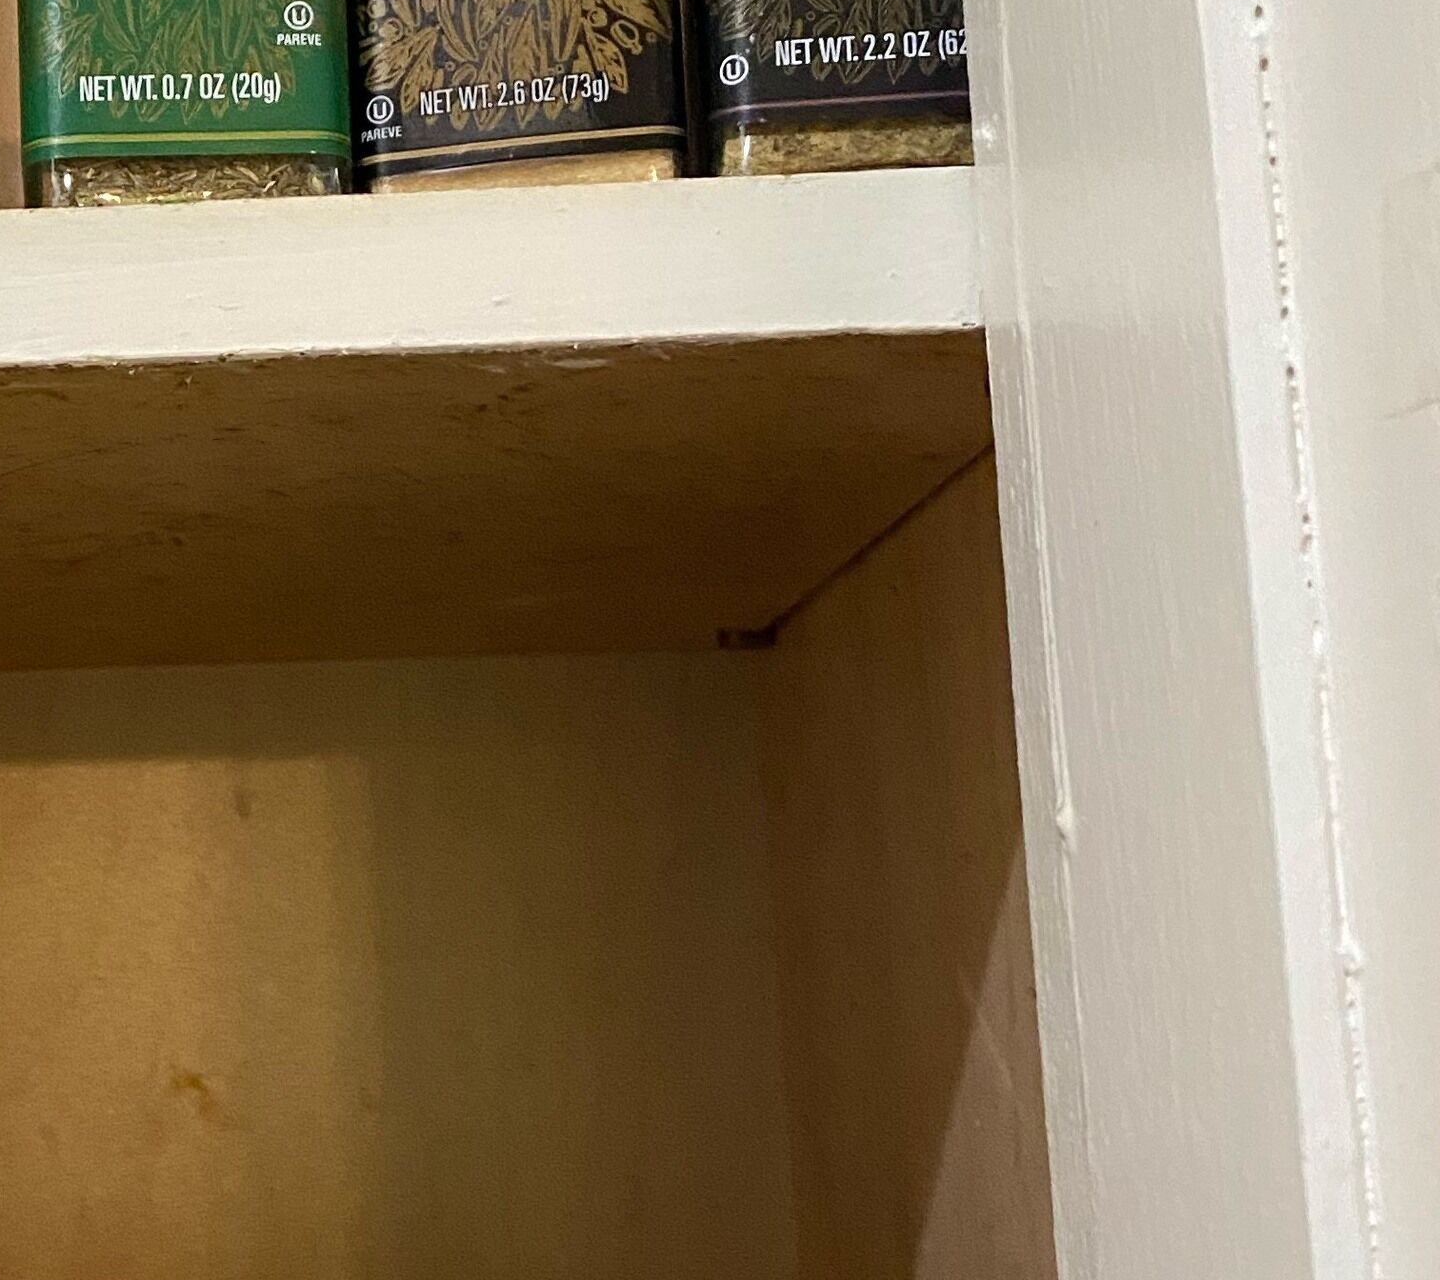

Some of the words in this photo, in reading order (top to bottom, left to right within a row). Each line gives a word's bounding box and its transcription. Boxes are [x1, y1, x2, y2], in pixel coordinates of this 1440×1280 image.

[276, 32, 321, 46] PAREVE
[775, 38, 814, 66] NET
[819, 36, 858, 63] WT.
[863, 33, 896, 60] 2.2
[903, 31, 931, 57] OZ
[79, 74, 118, 101] NET
[120, 74, 159, 101] WT.
[162, 73, 194, 100] 0.7
[198, 72, 225, 98] OZ
[232, 72, 281, 103] (20g)
[420, 88, 454, 116] NET
[458, 85, 494, 112] WT.
[498, 80, 526, 107] 2.6
[532, 77, 555, 104] OZ
[562, 72, 610, 104] (73g)
[361, 125, 402, 144] PAREVE
